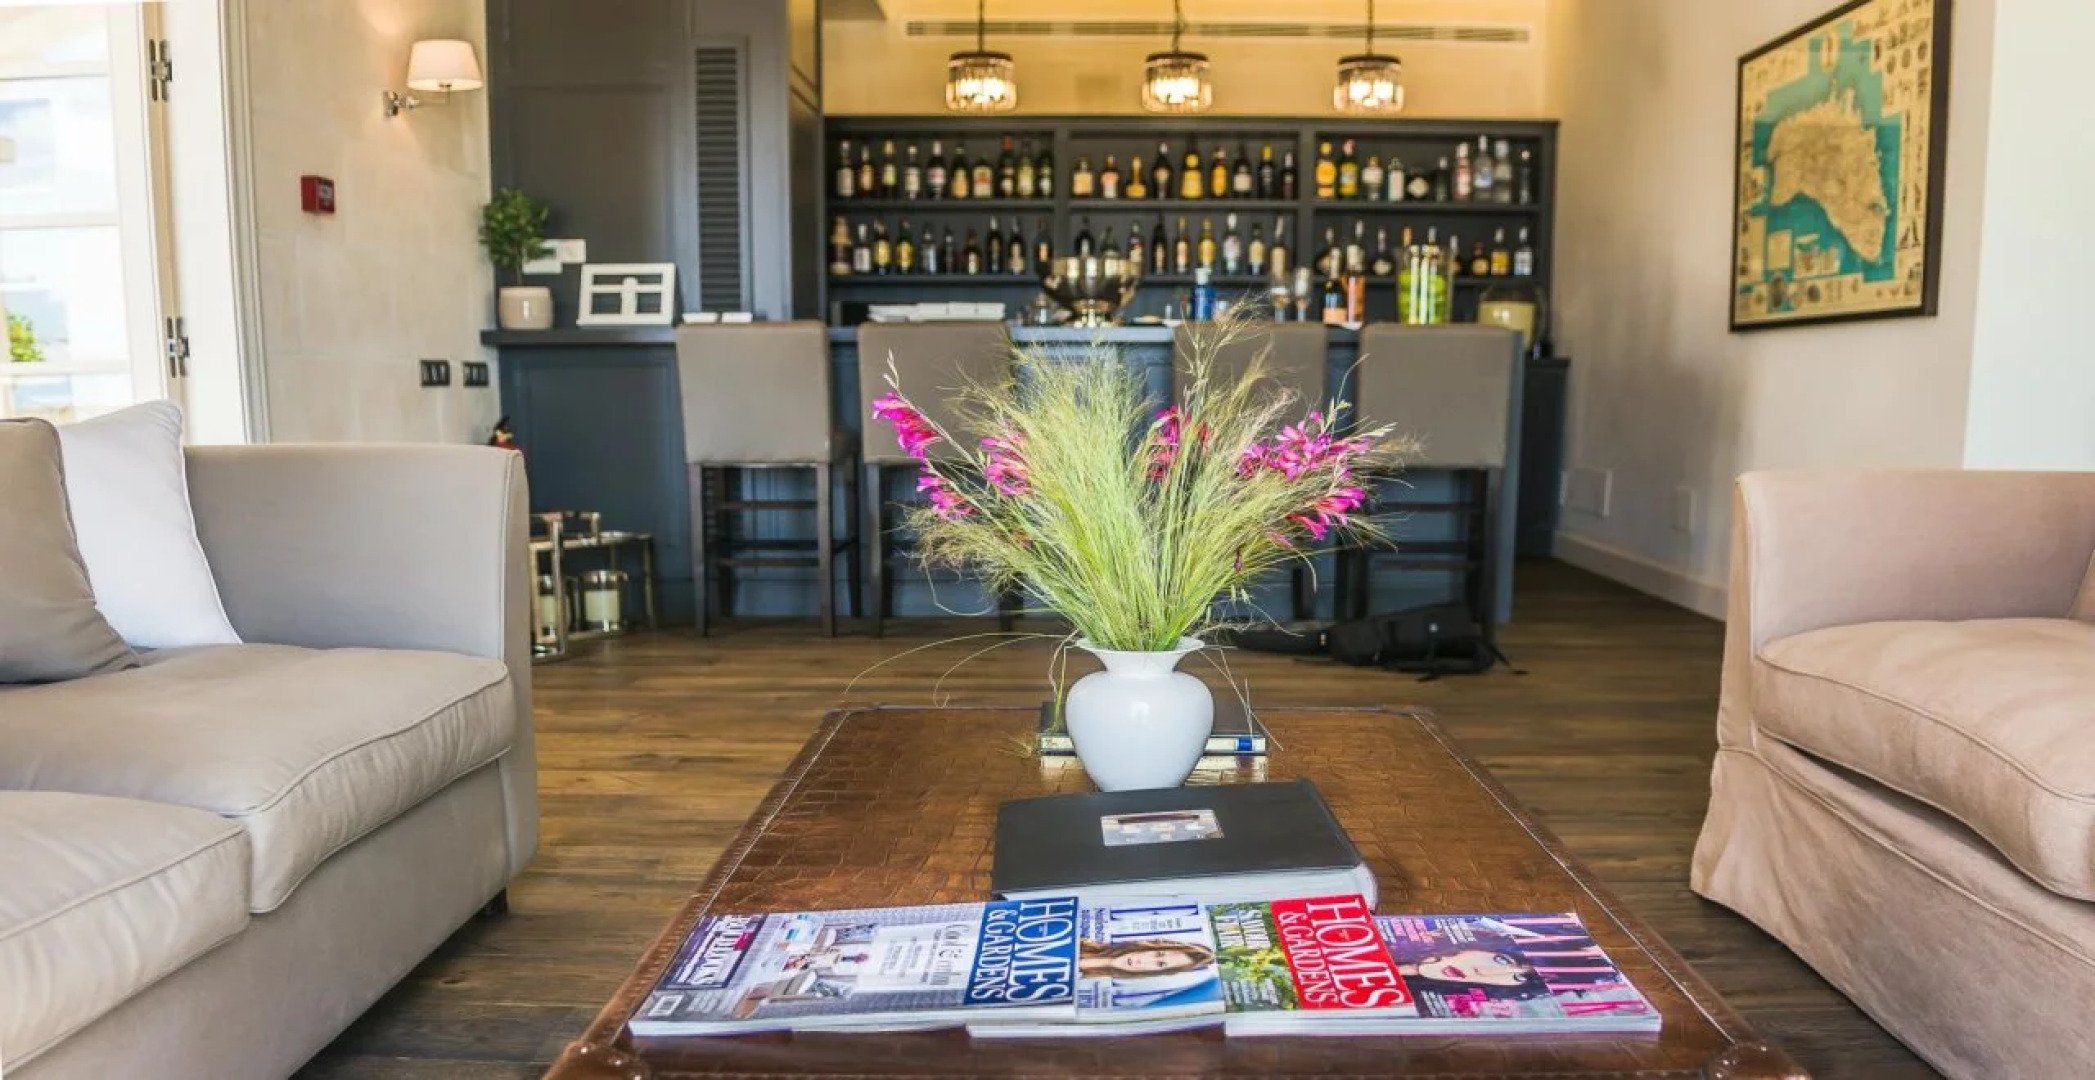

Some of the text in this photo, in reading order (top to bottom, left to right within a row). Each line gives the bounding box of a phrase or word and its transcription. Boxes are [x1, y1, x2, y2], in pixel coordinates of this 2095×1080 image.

[970, 921, 1017, 1000] GARDENS
[1005, 899, 1075, 1001] HOMES
[1278, 911, 1339, 1003] & GARDENS
[1306, 897, 1406, 1009] HOMES
[1502, 912, 1650, 1016] TATLER
